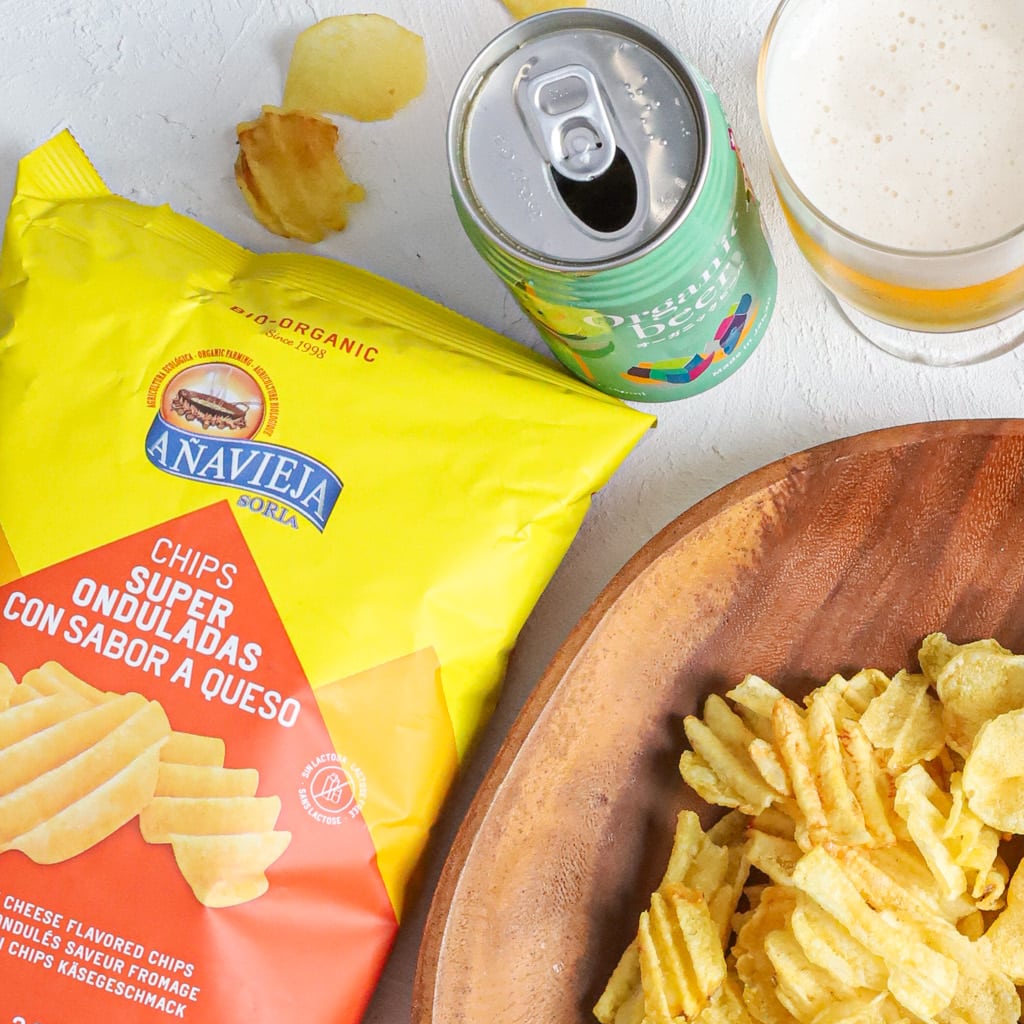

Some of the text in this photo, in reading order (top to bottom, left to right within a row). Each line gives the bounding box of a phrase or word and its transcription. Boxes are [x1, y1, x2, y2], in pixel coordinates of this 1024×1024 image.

[197, 348, 225, 359] ORGANIC
[225, 349, 253, 367] FARMING
[230, 305, 379, 363] BIO-ORGANIC
[265, 329, 327, 360] Since 1998
[147, 430, 328, 522] AÑAVIEJA
[236, 495, 299, 530] SORIA
[150, 537, 238, 590] CHIPS
[72, 577, 262, 672] ONDULADAS
[125, 565, 234, 629] SUPER
[3, 591, 302, 728] CON SABOR A QUESO
[298, 788, 311, 811] SANS
[301, 763, 314, 779] SIN
[307, 807, 343, 825] LACTOSE
[3, 895, 195, 978] CHEESE FLAVORED CHIPS
[8, 941, 187, 1019] CHIPS KÄSEGESCHMACK
[65, 941, 125, 975] SAVEUR
[127, 964, 201, 1001] FROMAGE
